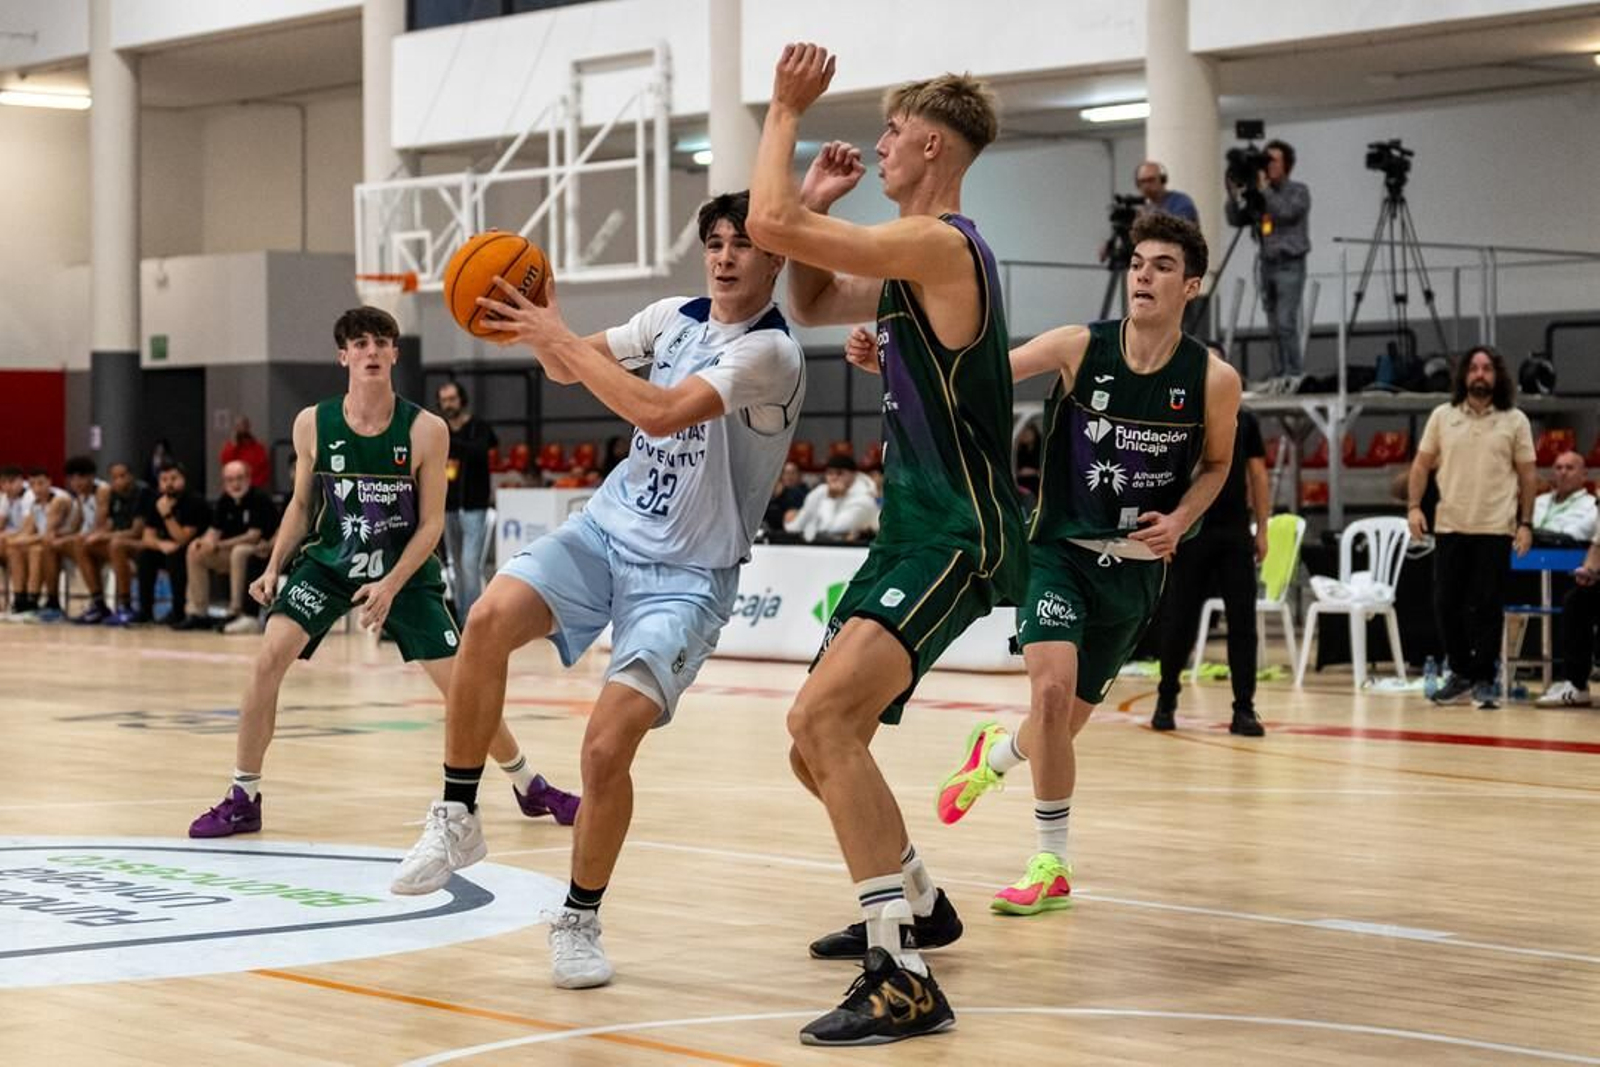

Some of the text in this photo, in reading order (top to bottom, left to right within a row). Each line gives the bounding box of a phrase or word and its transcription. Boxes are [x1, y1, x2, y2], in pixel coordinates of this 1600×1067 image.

[1115, 425, 1188, 443] Fundación
[1115, 439, 1168, 456] Unicaja
[635, 434, 706, 467] OVENTUT
[357, 480, 412, 493] Fundación
[358, 491, 397, 505] Unicaja
[636, 467, 678, 516] 32
[348, 551, 384, 578] 20
[731, 586, 782, 628] caja
[0, 867, 233, 908] Unicaja
[47, 855, 386, 907] Baloncesto
